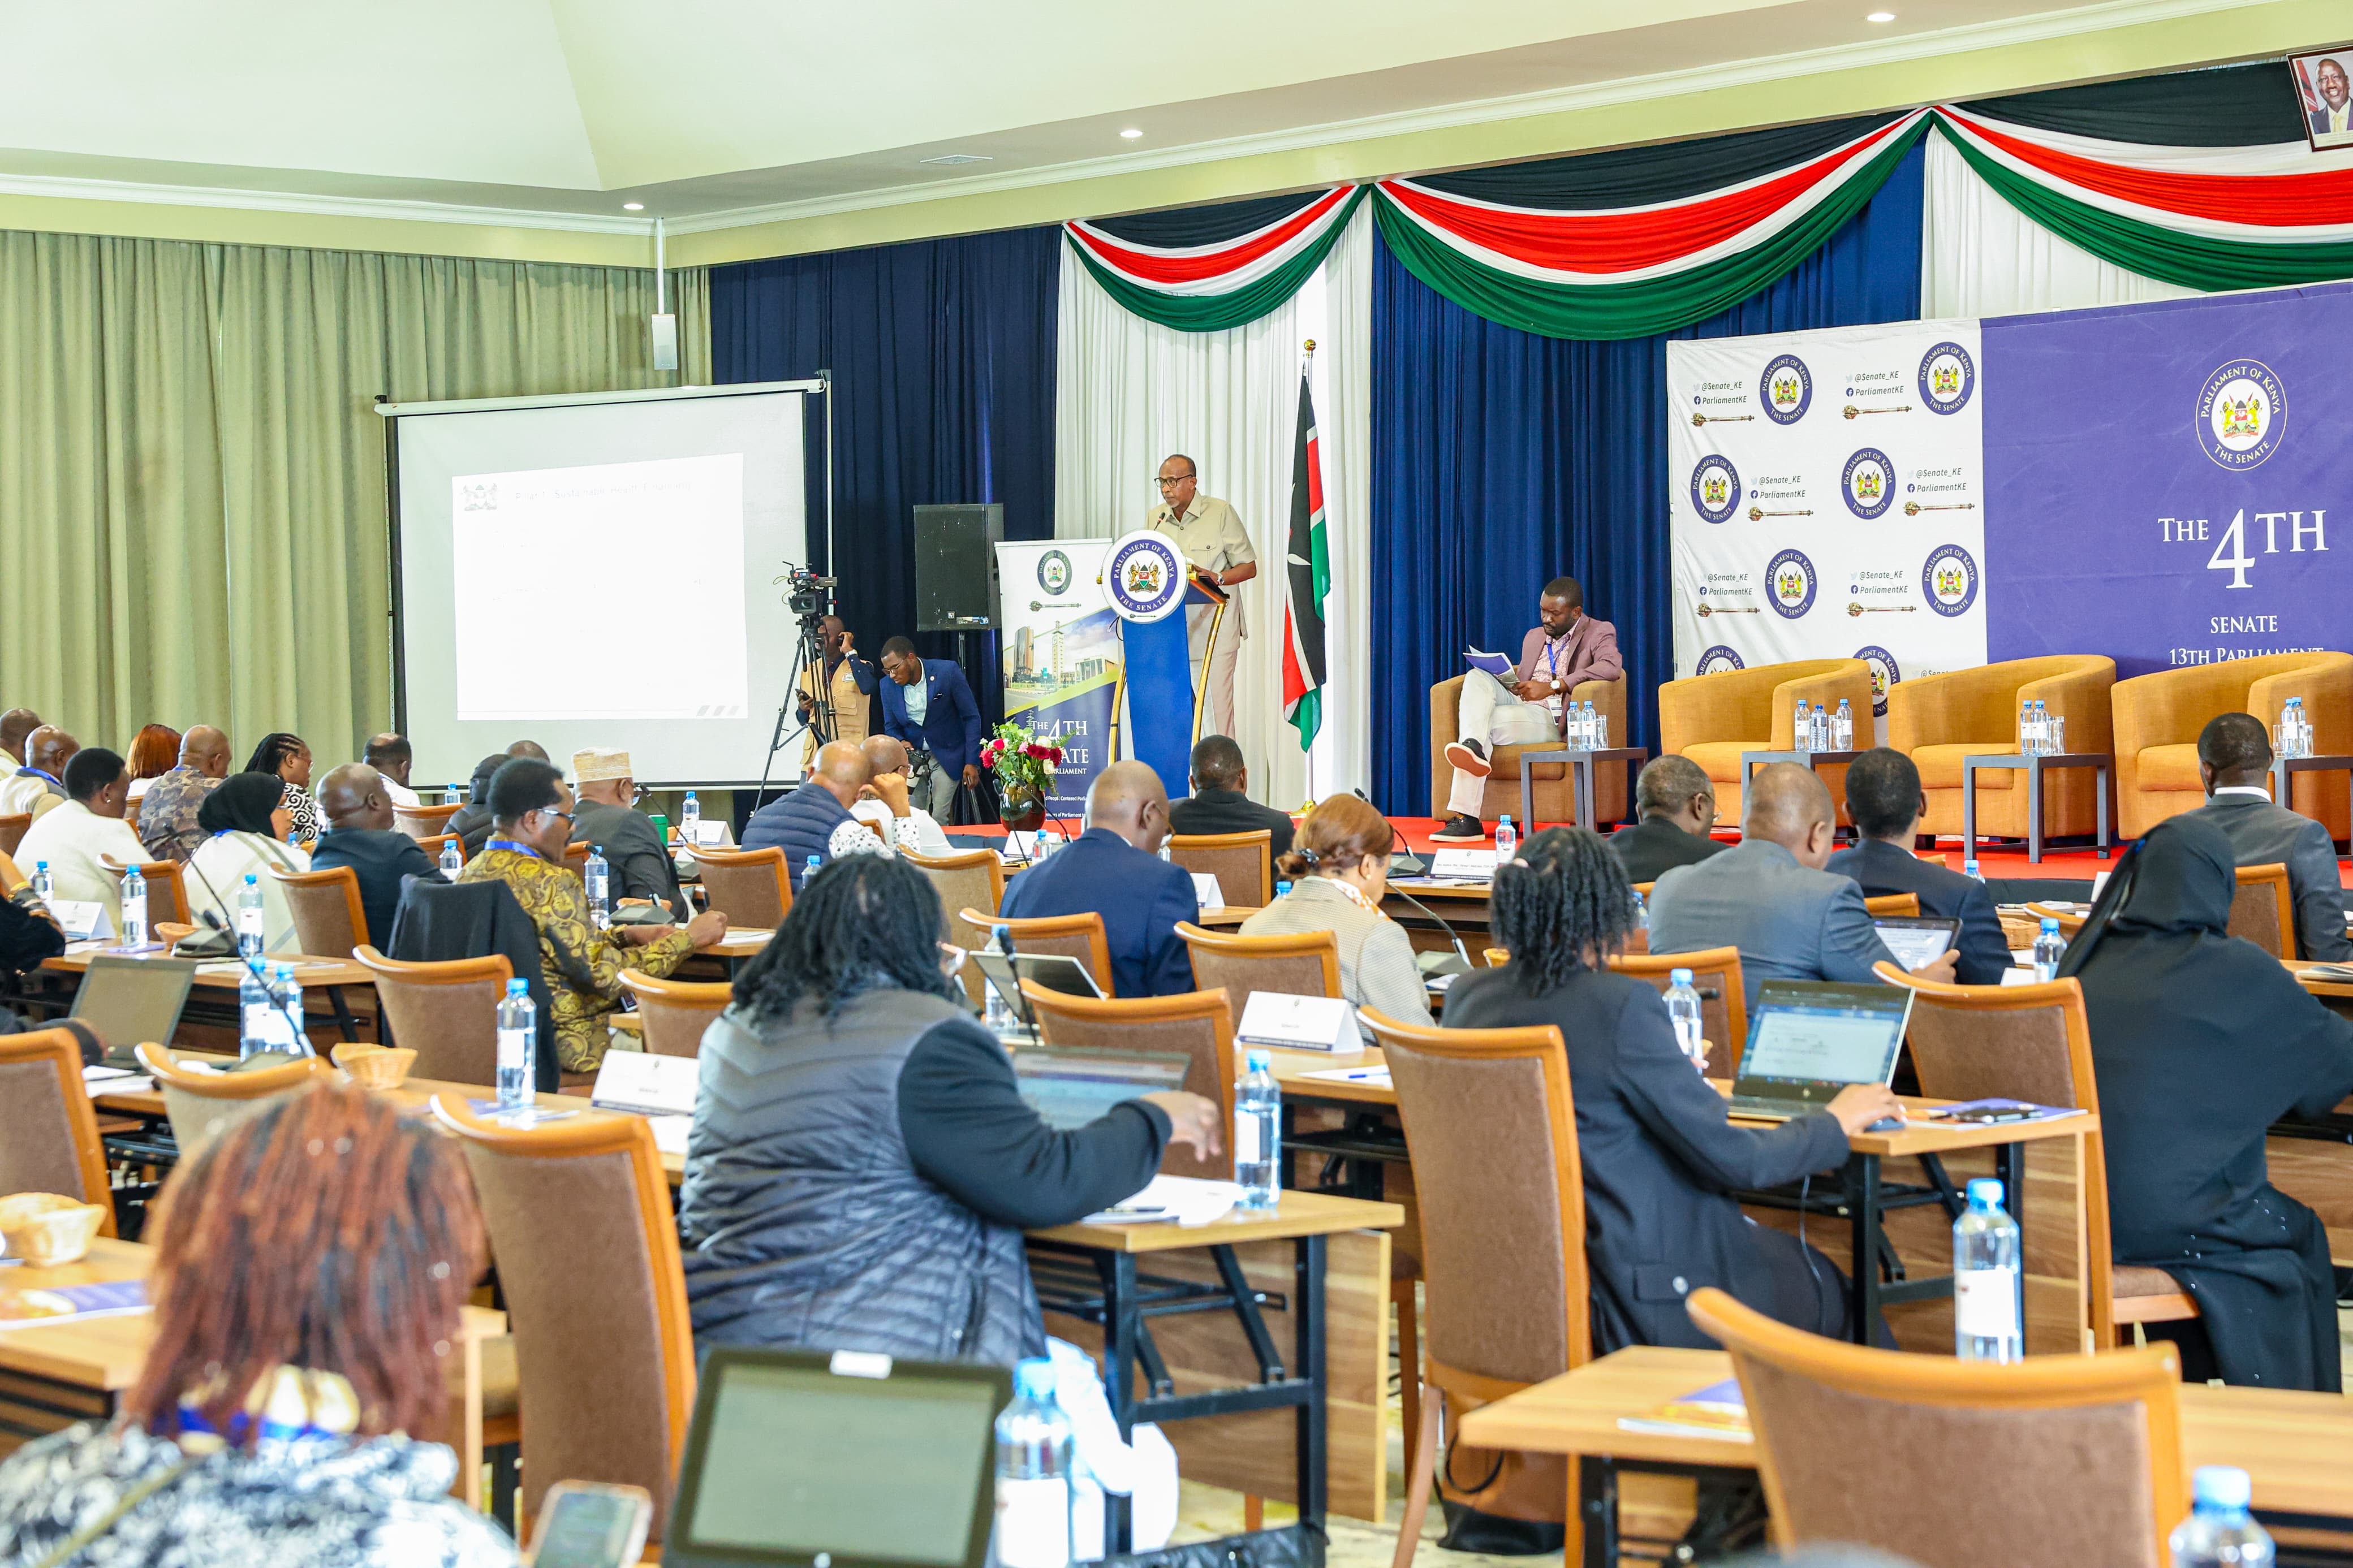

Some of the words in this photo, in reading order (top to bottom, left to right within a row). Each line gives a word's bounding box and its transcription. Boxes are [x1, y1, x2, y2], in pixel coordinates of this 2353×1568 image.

[1920, 346, 1950, 380] PARLIAMENT
[1960, 353, 1971, 378] KENYA
[1762, 358, 1789, 391] PARLIAMENT
[1798, 365, 1809, 390] KENYA
[1855, 371, 1899, 382] @Senate_KE
[1701, 381, 1742, 391] @Senate_KE
[1856, 386, 1904, 396] ParliamentKE
[2201, 367, 2247, 417] PARLIAMENT
[2250, 368, 2262, 379] OF
[2262, 377, 2281, 414] KENYA
[1703, 396, 1747, 404] ParliamentKE
[1930, 398, 1941, 410] THE
[1943, 396, 1964, 411] SENATE
[1770, 408, 1782, 420] THE
[1783, 407, 1803, 421] SENATE
[2214, 444, 2233, 462] THE
[2236, 440, 2270, 464] SENATE
[1693, 459, 1718, 490] PARLIAMENT
[1727, 466, 1738, 490] KENYA
[1844, 452, 1871, 484] PARLIAMENT
[1881, 459, 1892, 484] KENYA
[1916, 468, 1962, 478] @Senate_KE
[1760, 476, 1801, 485] @Senate_KE
[1917, 483, 1967, 492] ParliamentKE
[1701, 507, 1711, 519] THE
[1713, 507, 1732, 520] SENATE
[1852, 502, 1864, 515] THE
[1866, 501, 1886, 515] SENATE
[2158, 517, 2209, 542] THE
[2207, 508, 2329, 589] 4TH
[1114, 543, 1149, 578] PARLIAMENT
[1161, 552, 1174, 578] KENYA
[1924, 548, 1953, 581] PARLIAMENT
[1963, 556, 1975, 581] KENYA
[1768, 553, 1794, 584] PARLIAMENT
[1803, 561, 1813, 585] KENYA
[1860, 571, 1903, 580] @Senate_KE
[1708, 573, 1748, 582] @Senate_KE
[1860, 585, 1908, 594] ParliamentKE
[1120, 595, 1134, 608] THE
[1136, 595, 1167, 611] SENATE
[1776, 602, 1787, 614] THE
[1789, 602, 1808, 615] SENATE
[1934, 599, 1946, 612] THE
[1947, 598, 1968, 613] SENATE
[2210, 615, 2278, 634] SENATE
[1699, 649, 1724, 675] ARLIAMENT
[2169, 648, 2210, 664] 13TH
[1886, 658, 1897, 683] KENYA
[1032, 720, 1048, 729] THE
[1061, 748, 1089, 763] ATE
